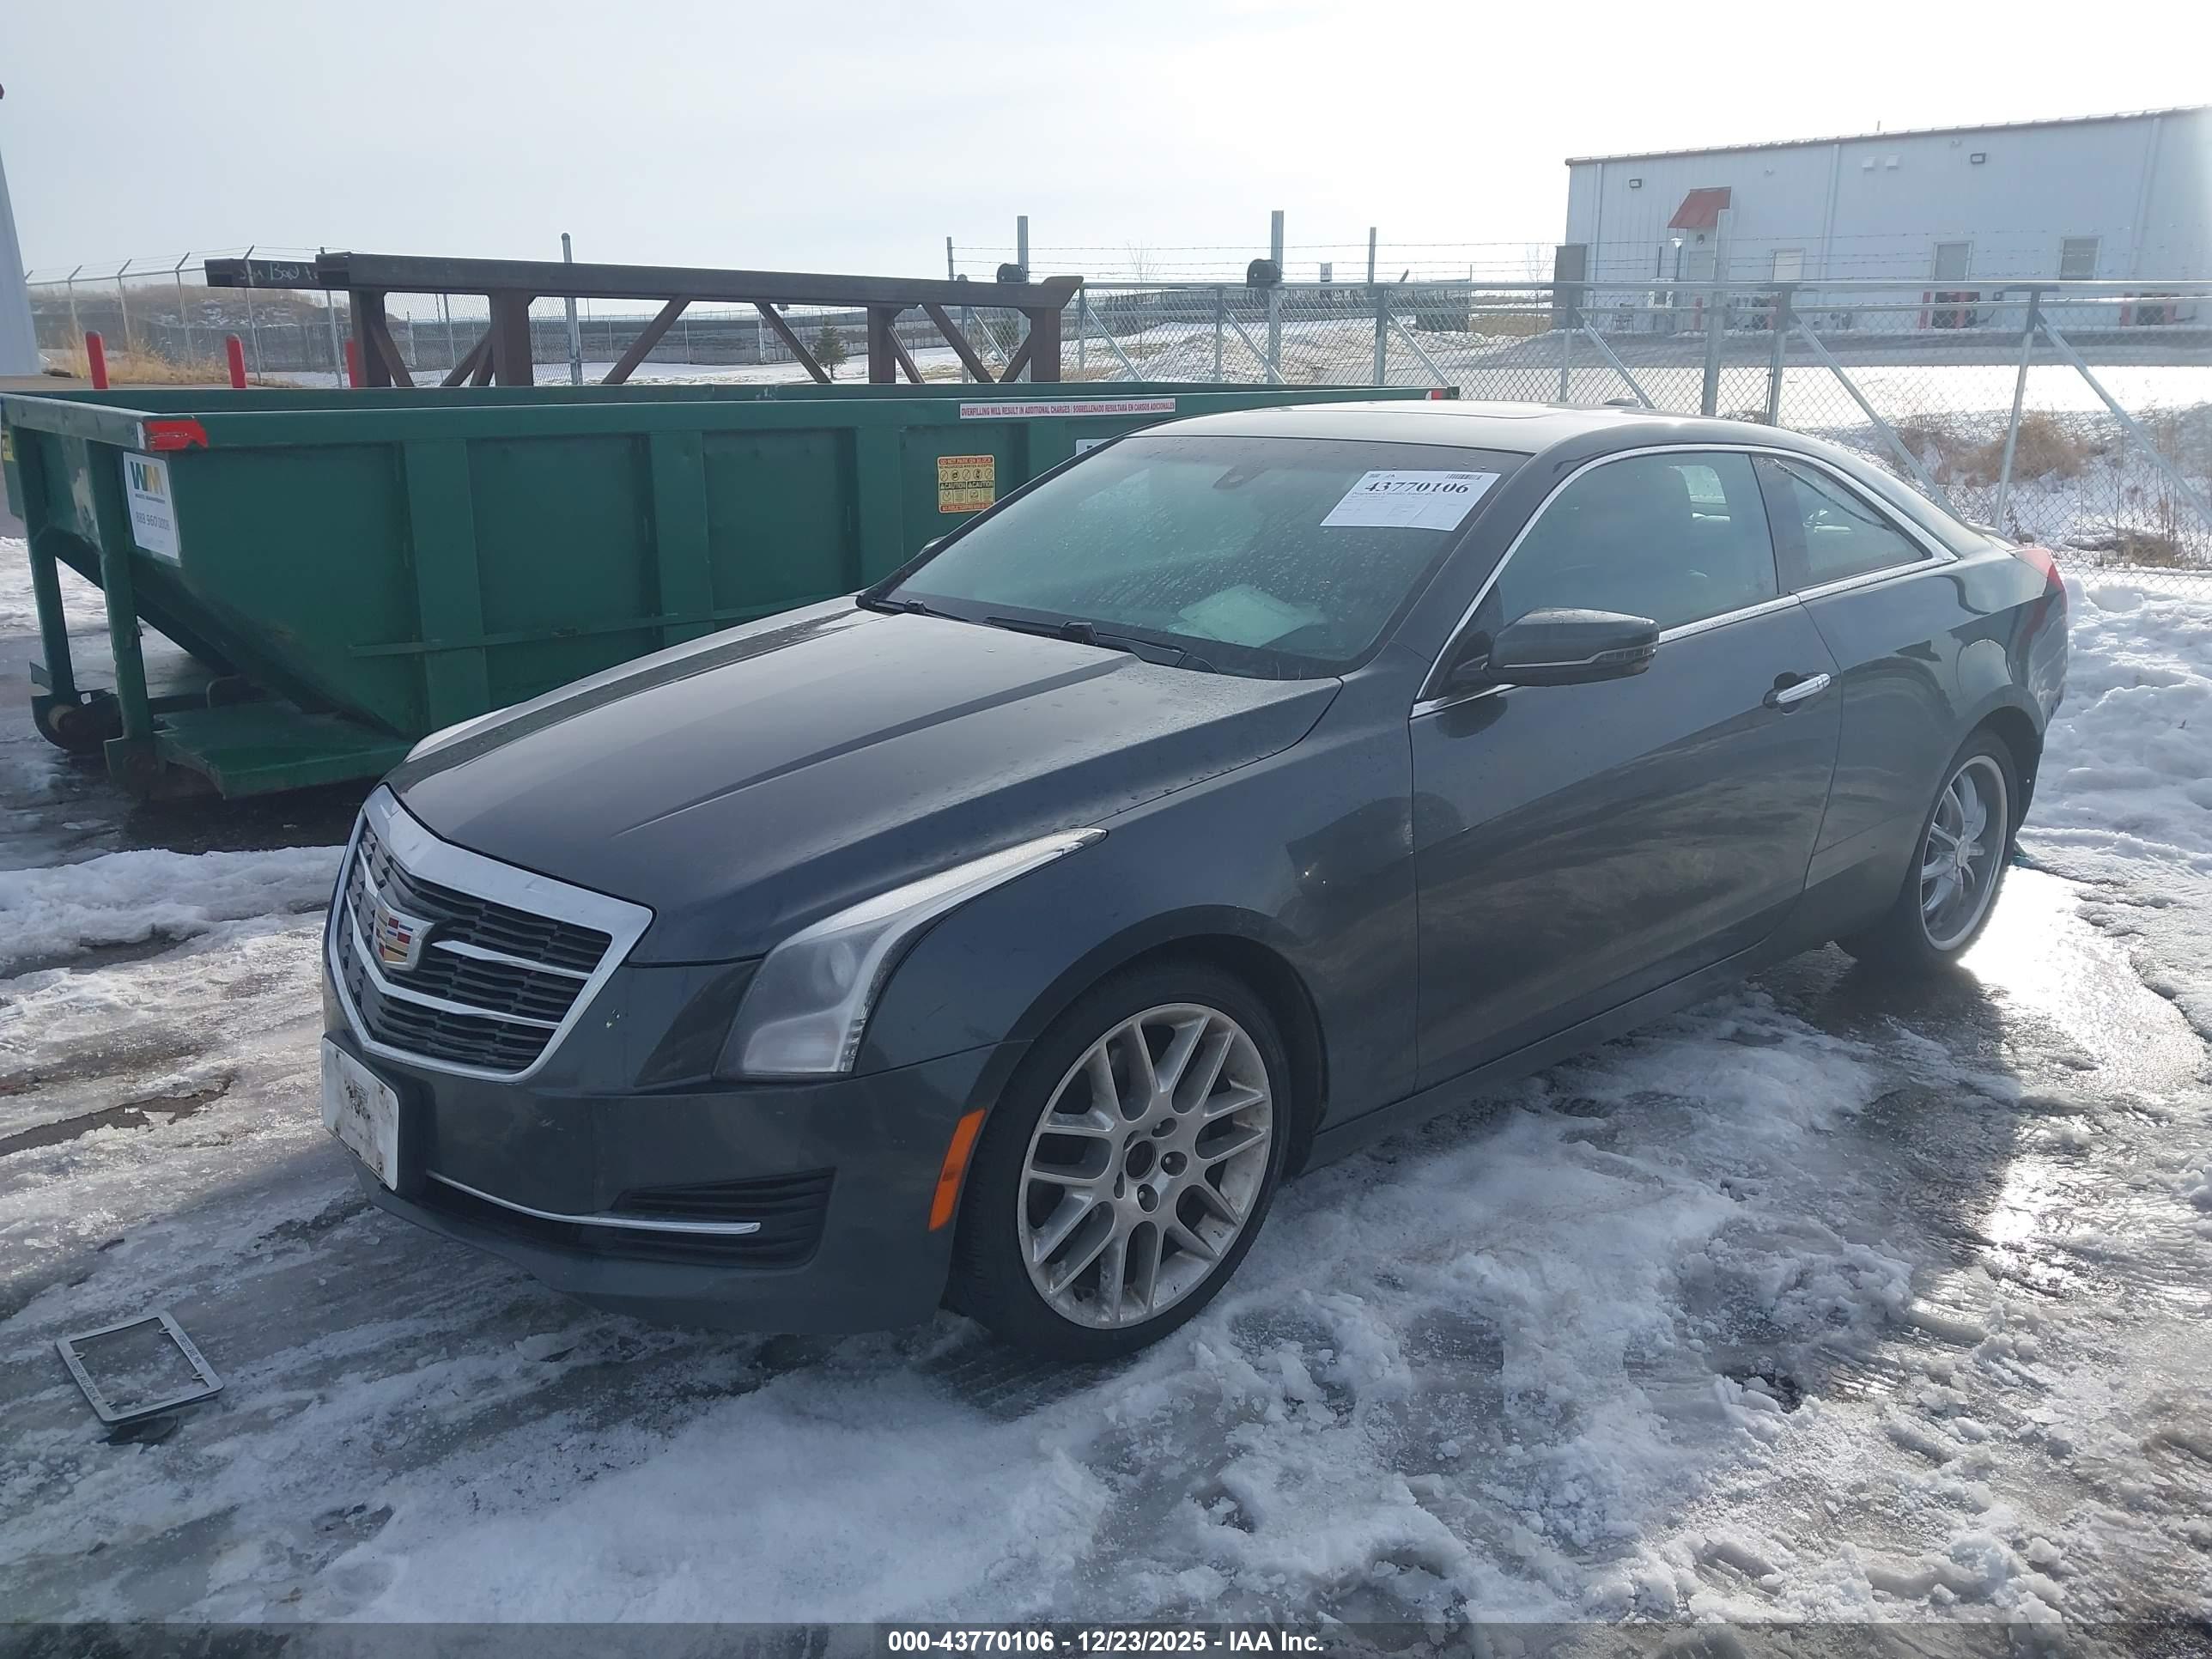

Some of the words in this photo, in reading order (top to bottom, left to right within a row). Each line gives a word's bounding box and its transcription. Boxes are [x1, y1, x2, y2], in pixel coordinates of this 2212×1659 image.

[961, 408, 989, 416] OVERFILLING
[991, 407, 1001, 416] WILL
[1024, 405, 1049, 414] ADDITIONAL
[1050, 405, 1070, 414] CHARGES
[1073, 404, 1104, 413] SOBRELLENADO
[131, 461, 164, 495] WM
[1364, 481, 1472, 494] 43770106
